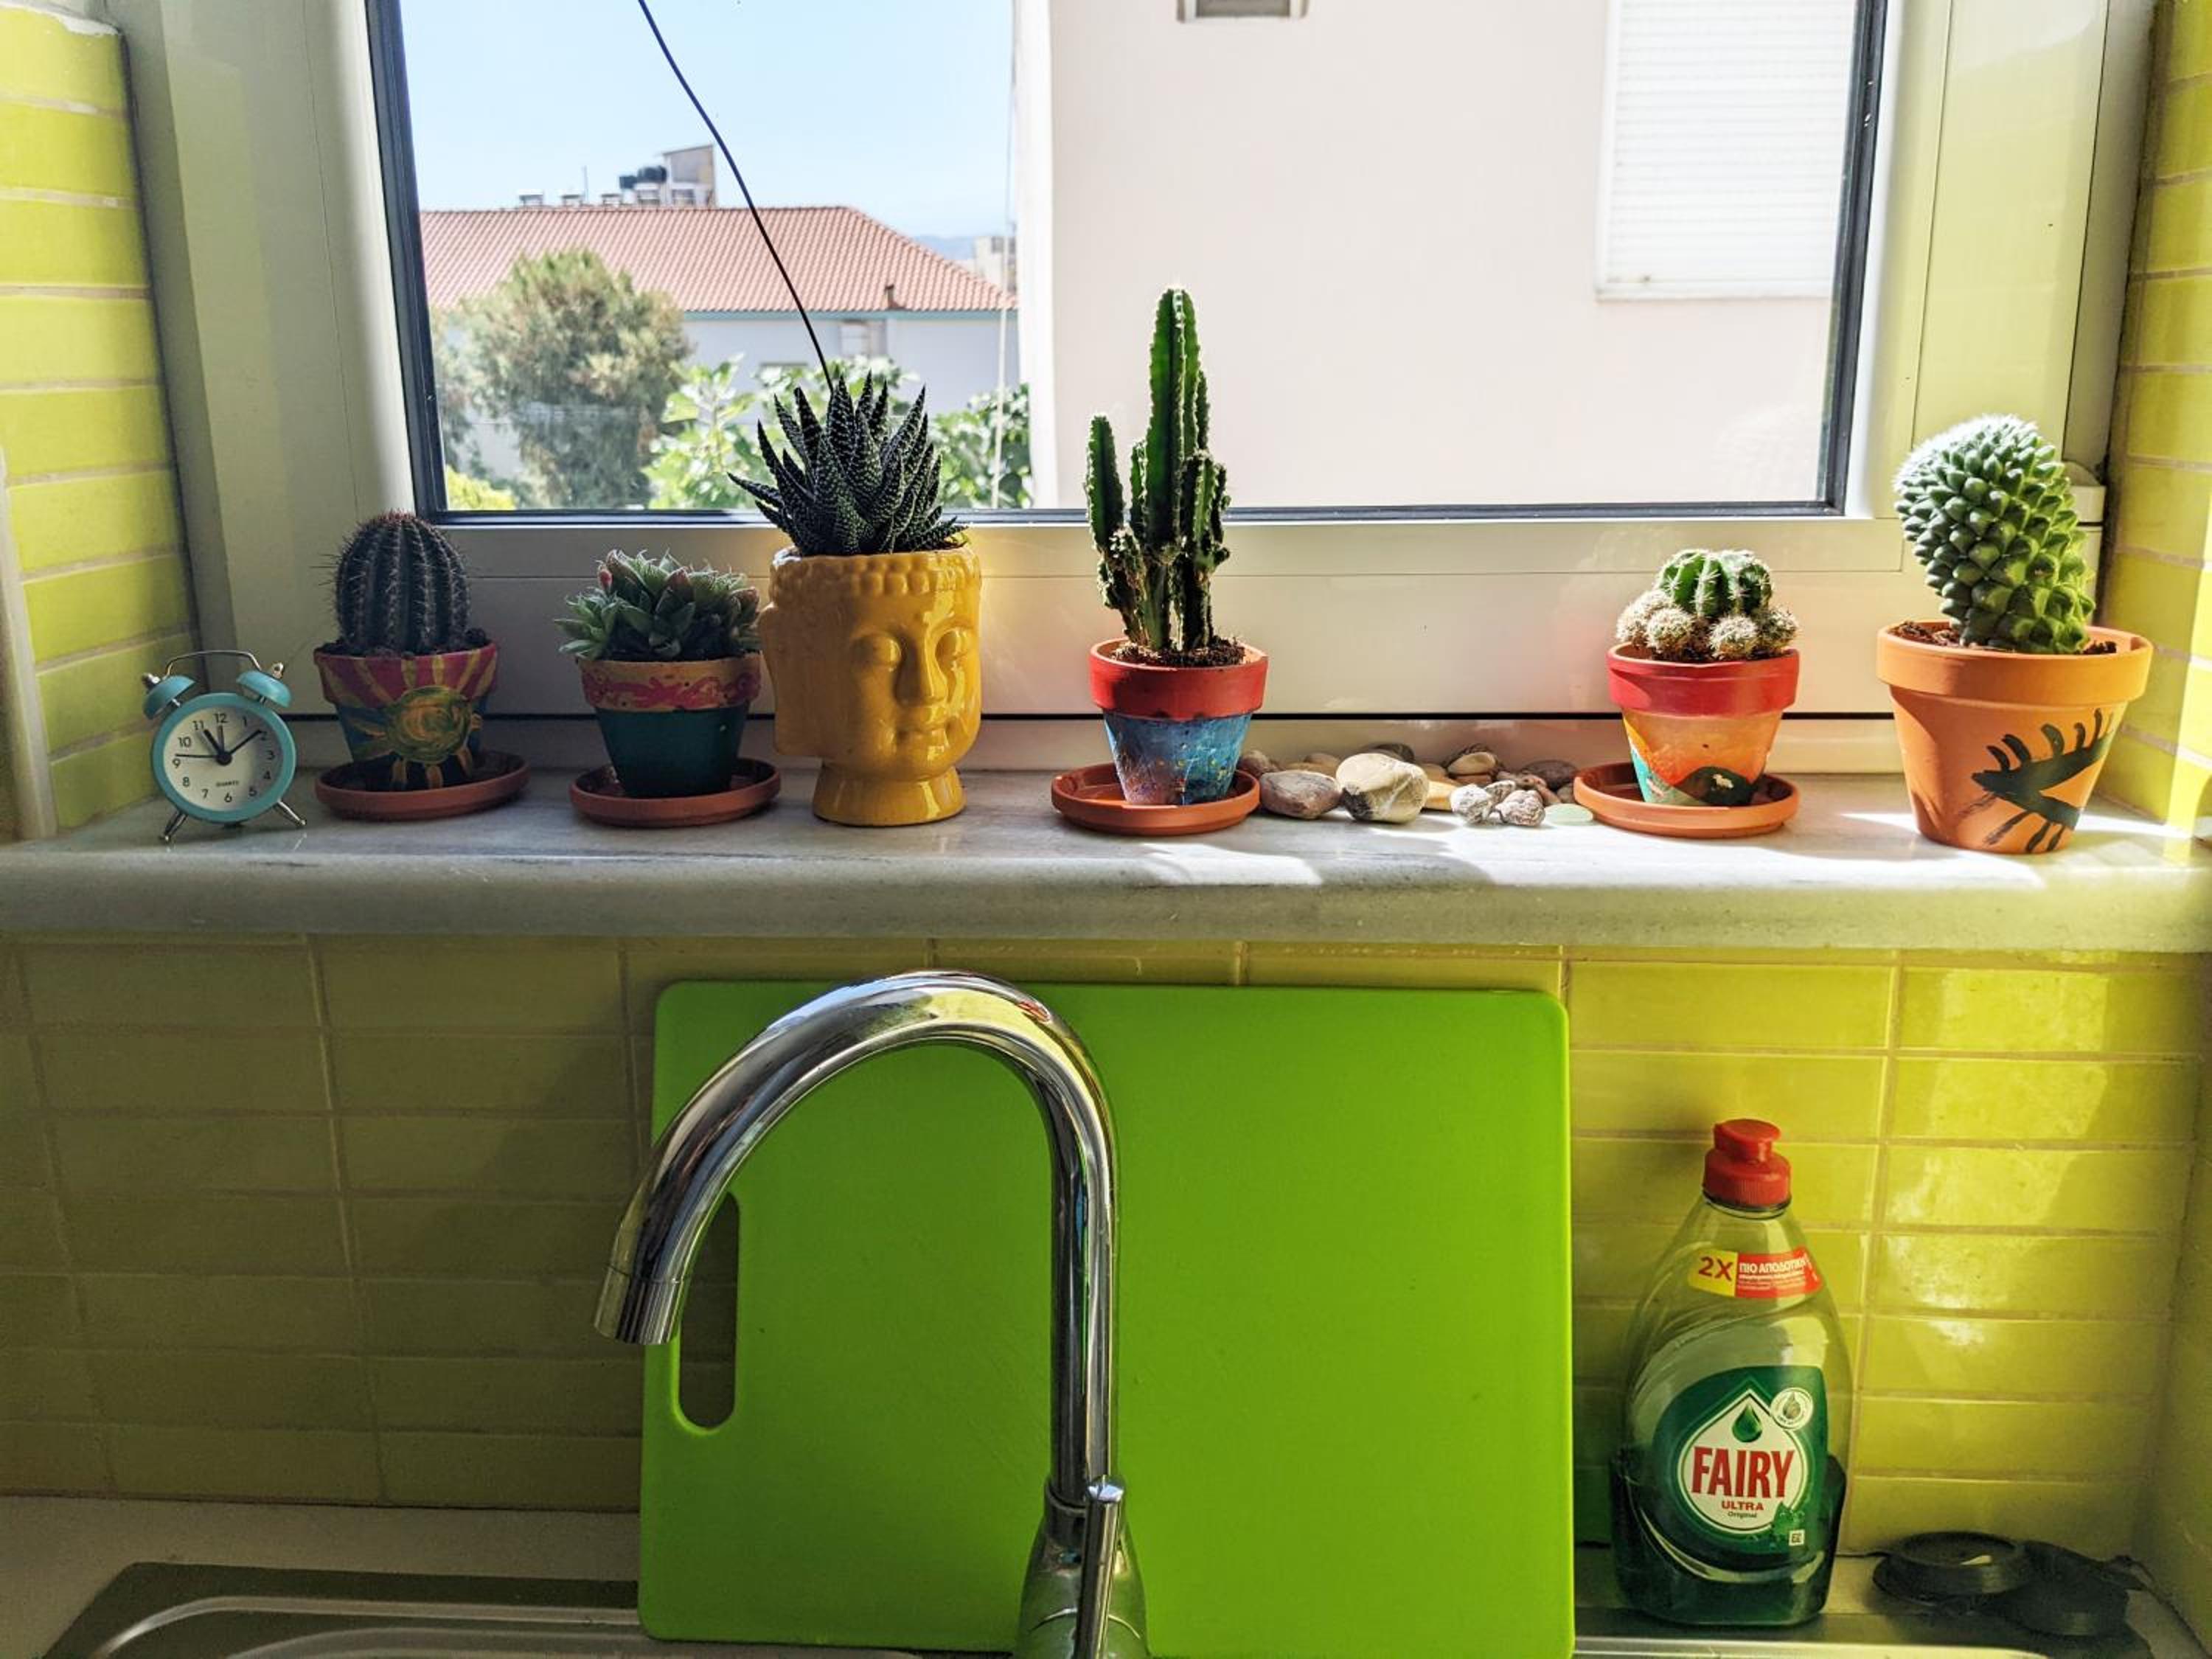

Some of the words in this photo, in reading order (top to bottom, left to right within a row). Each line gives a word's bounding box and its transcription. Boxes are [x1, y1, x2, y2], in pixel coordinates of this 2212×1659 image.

[214, 713, 229, 723] 12
[243, 716, 248, 726] 1
[192, 720, 204, 731] 11
[178, 737, 191, 748] 10
[267, 750, 275, 760] 3
[172, 758, 181, 769] 9
[263, 771, 271, 780] 4
[182, 776, 190, 787] 8
[201, 789, 209, 800] 7
[249, 787, 257, 796] 5
[224, 793, 233, 804] 6
[1699, 1256, 1733, 1281] 2X
[1739, 1262, 1758, 1273] ΠΙΟ
[1691, 1446, 1795, 1498] FAIRY
[1722, 1500, 1764, 1511] ULTRA
